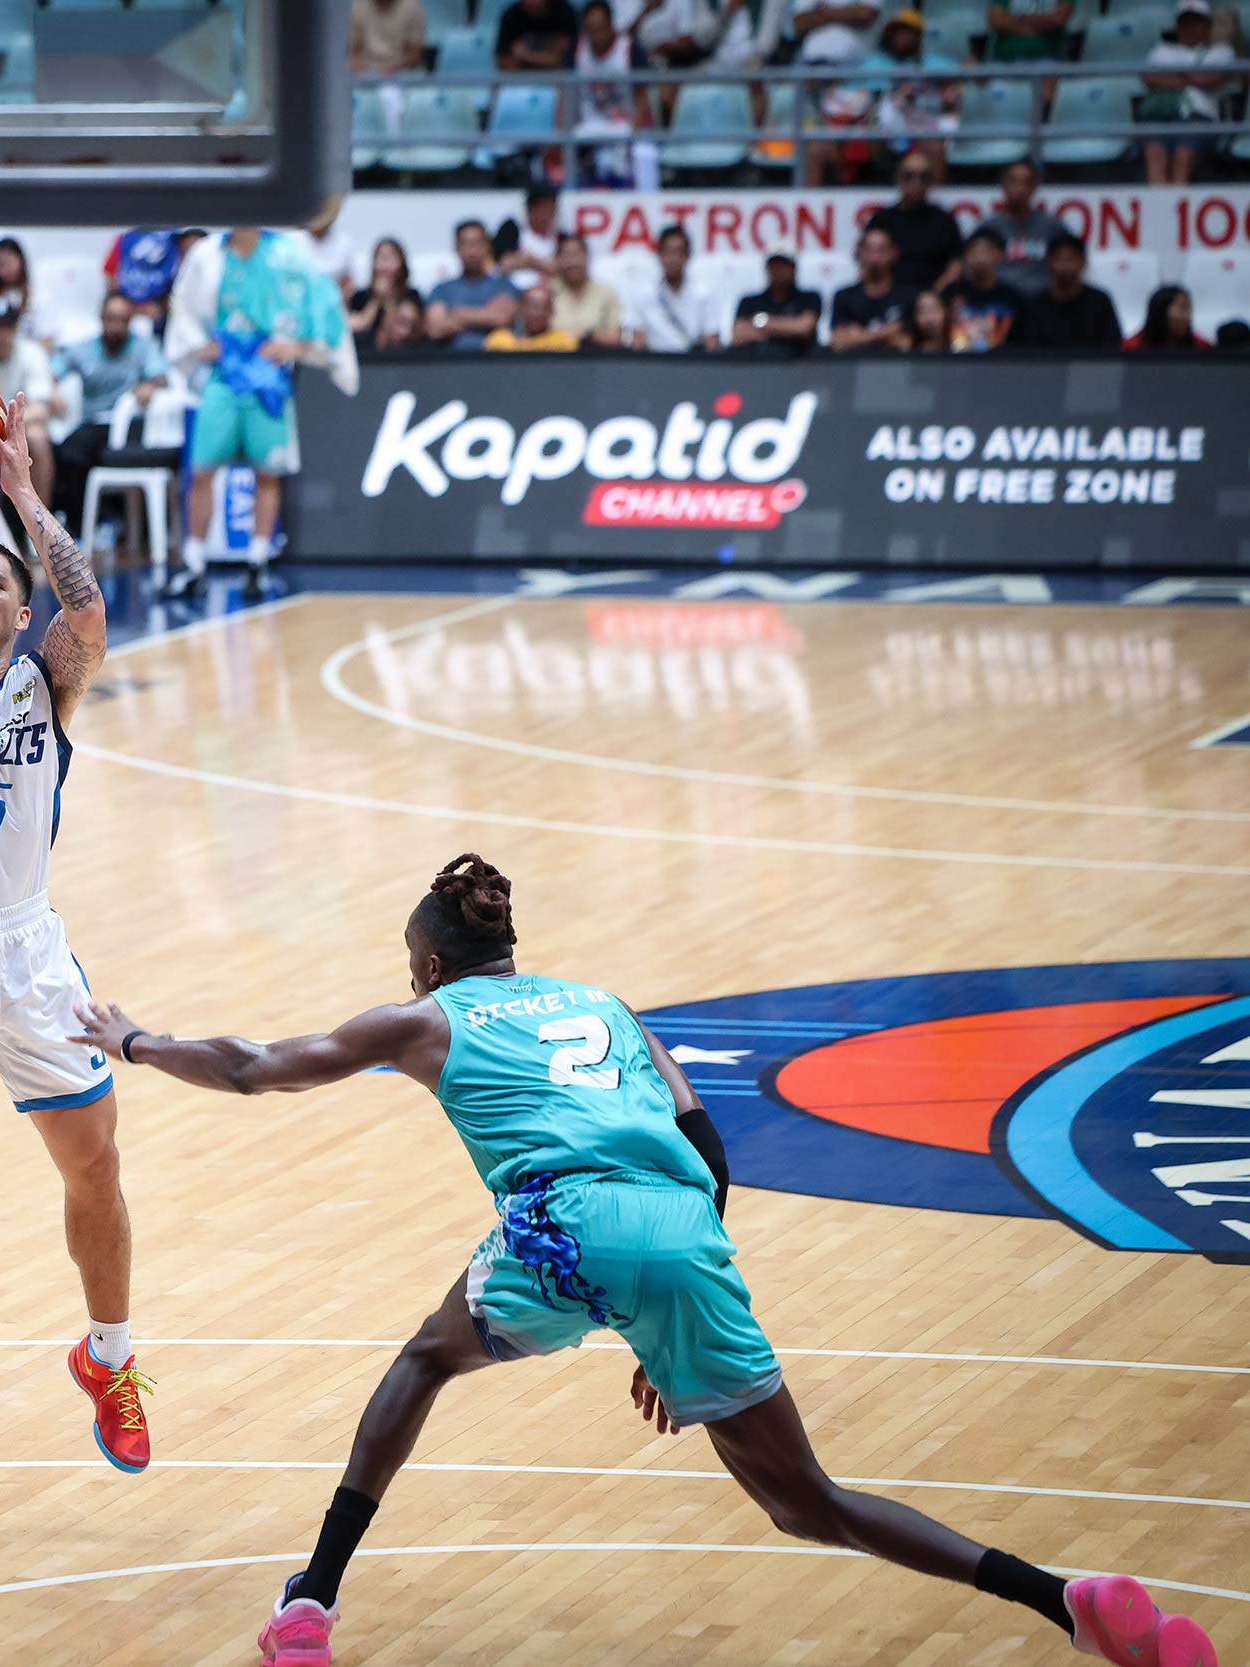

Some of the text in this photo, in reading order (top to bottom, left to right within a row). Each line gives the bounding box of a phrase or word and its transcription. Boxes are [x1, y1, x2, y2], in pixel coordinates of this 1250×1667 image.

[575, 202, 835, 253] PATRON
[1176, 196, 1250, 252] 10
[361, 390, 818, 507] Kapatid
[865, 425, 1205, 462] ALSO AVAILABLE
[598, 486, 770, 523] CHANNEL
[884, 467, 1176, 504] ON FREE ZONE
[466, 988, 578, 1028] DICKEY
[538, 1014, 621, 1090] 2
